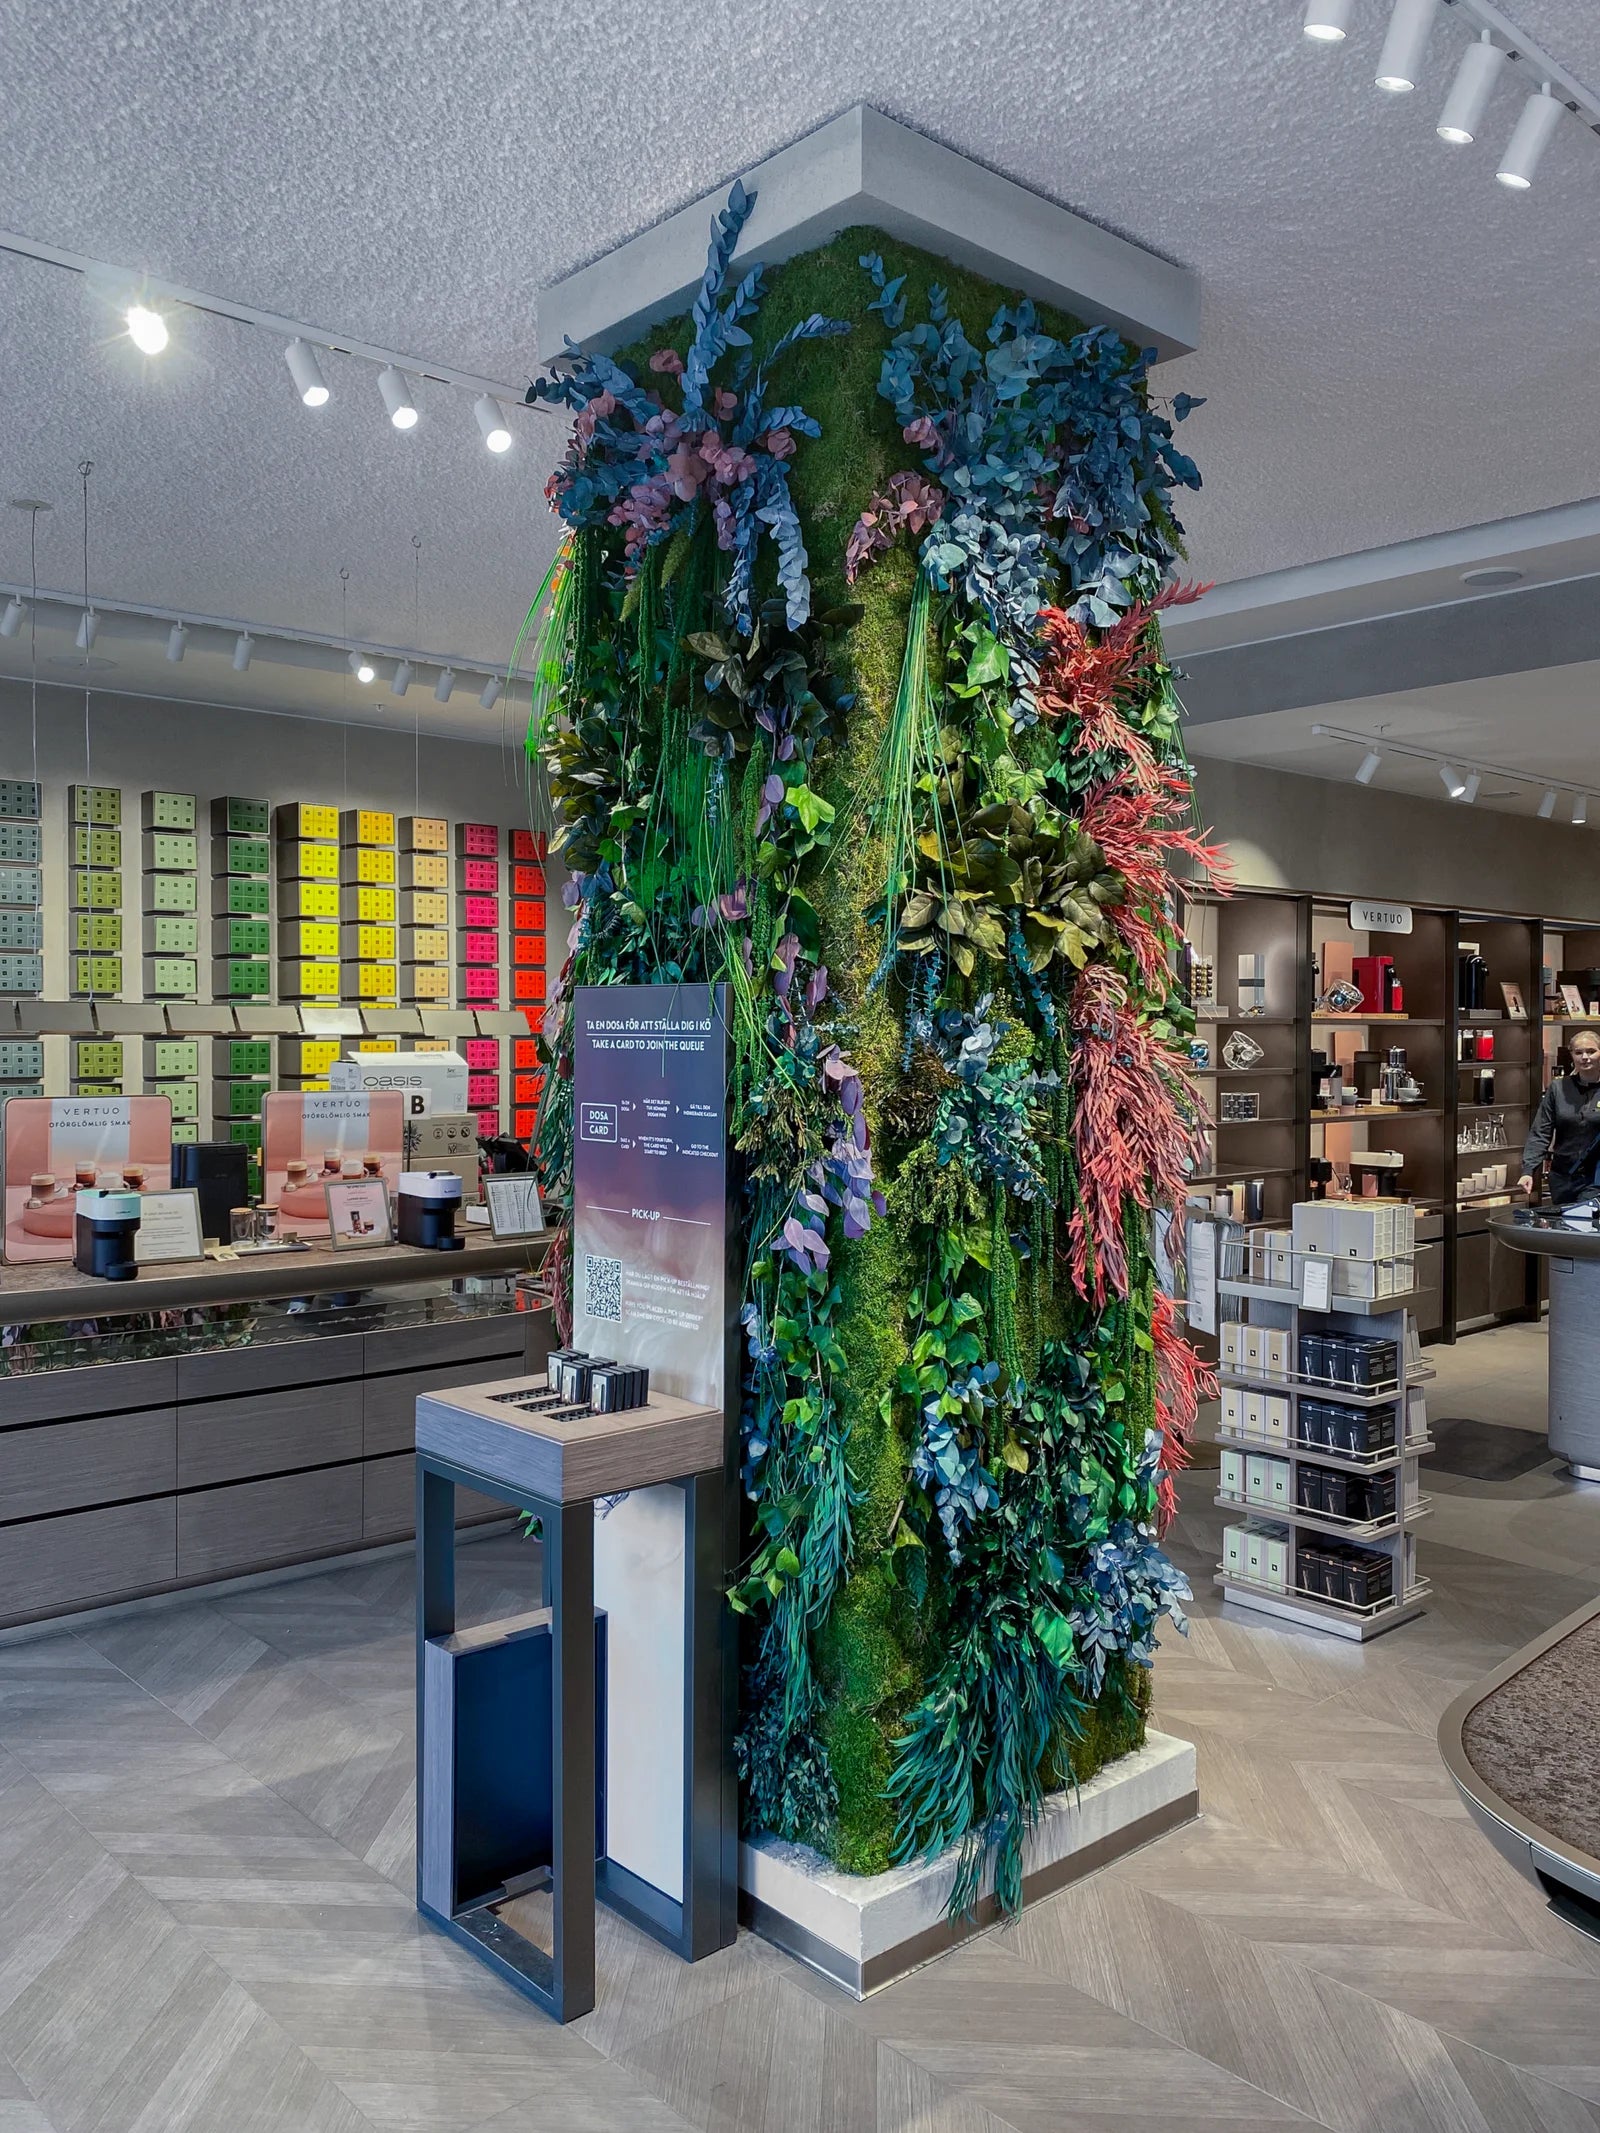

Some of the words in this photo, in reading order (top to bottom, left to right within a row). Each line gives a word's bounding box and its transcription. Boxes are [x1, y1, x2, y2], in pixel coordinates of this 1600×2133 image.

[1363, 911, 1403, 924] VERTUO
[586, 1020, 595, 1030] TA
[595, 1020, 605, 1030] EN
[606, 1020, 625, 1030] DOSA
[625, 1018, 640, 1030] FÖR
[640, 1020, 654, 1030] ATT
[654, 1018, 680, 1030] STÄLLA
[681, 1020, 695, 1030] DIG
[695, 1020, 699, 1030] I
[699, 1018, 711, 1030] KÖ
[592, 1039, 610, 1049] TAKE
[610, 1040, 616, 1049] A
[616, 1039, 635, 1050] CARD
[635, 1040, 646, 1050] TO
[646, 1040, 664, 1050] JOIN
[665, 1040, 679, 1050] THE
[679, 1040, 705, 1051] QUEUE
[313, 1100, 361, 1108] VERTUO
[410, 1095, 425, 1115] B
[63, 1107, 120, 1115] VERTUO
[590, 1110, 609, 1121] DOSA
[48, 1120, 108, 1128] OFÖRGLÖMLIG
[589, 1125, 609, 1135] CARD
[631, 1208, 661, 1221] PICK-UP
